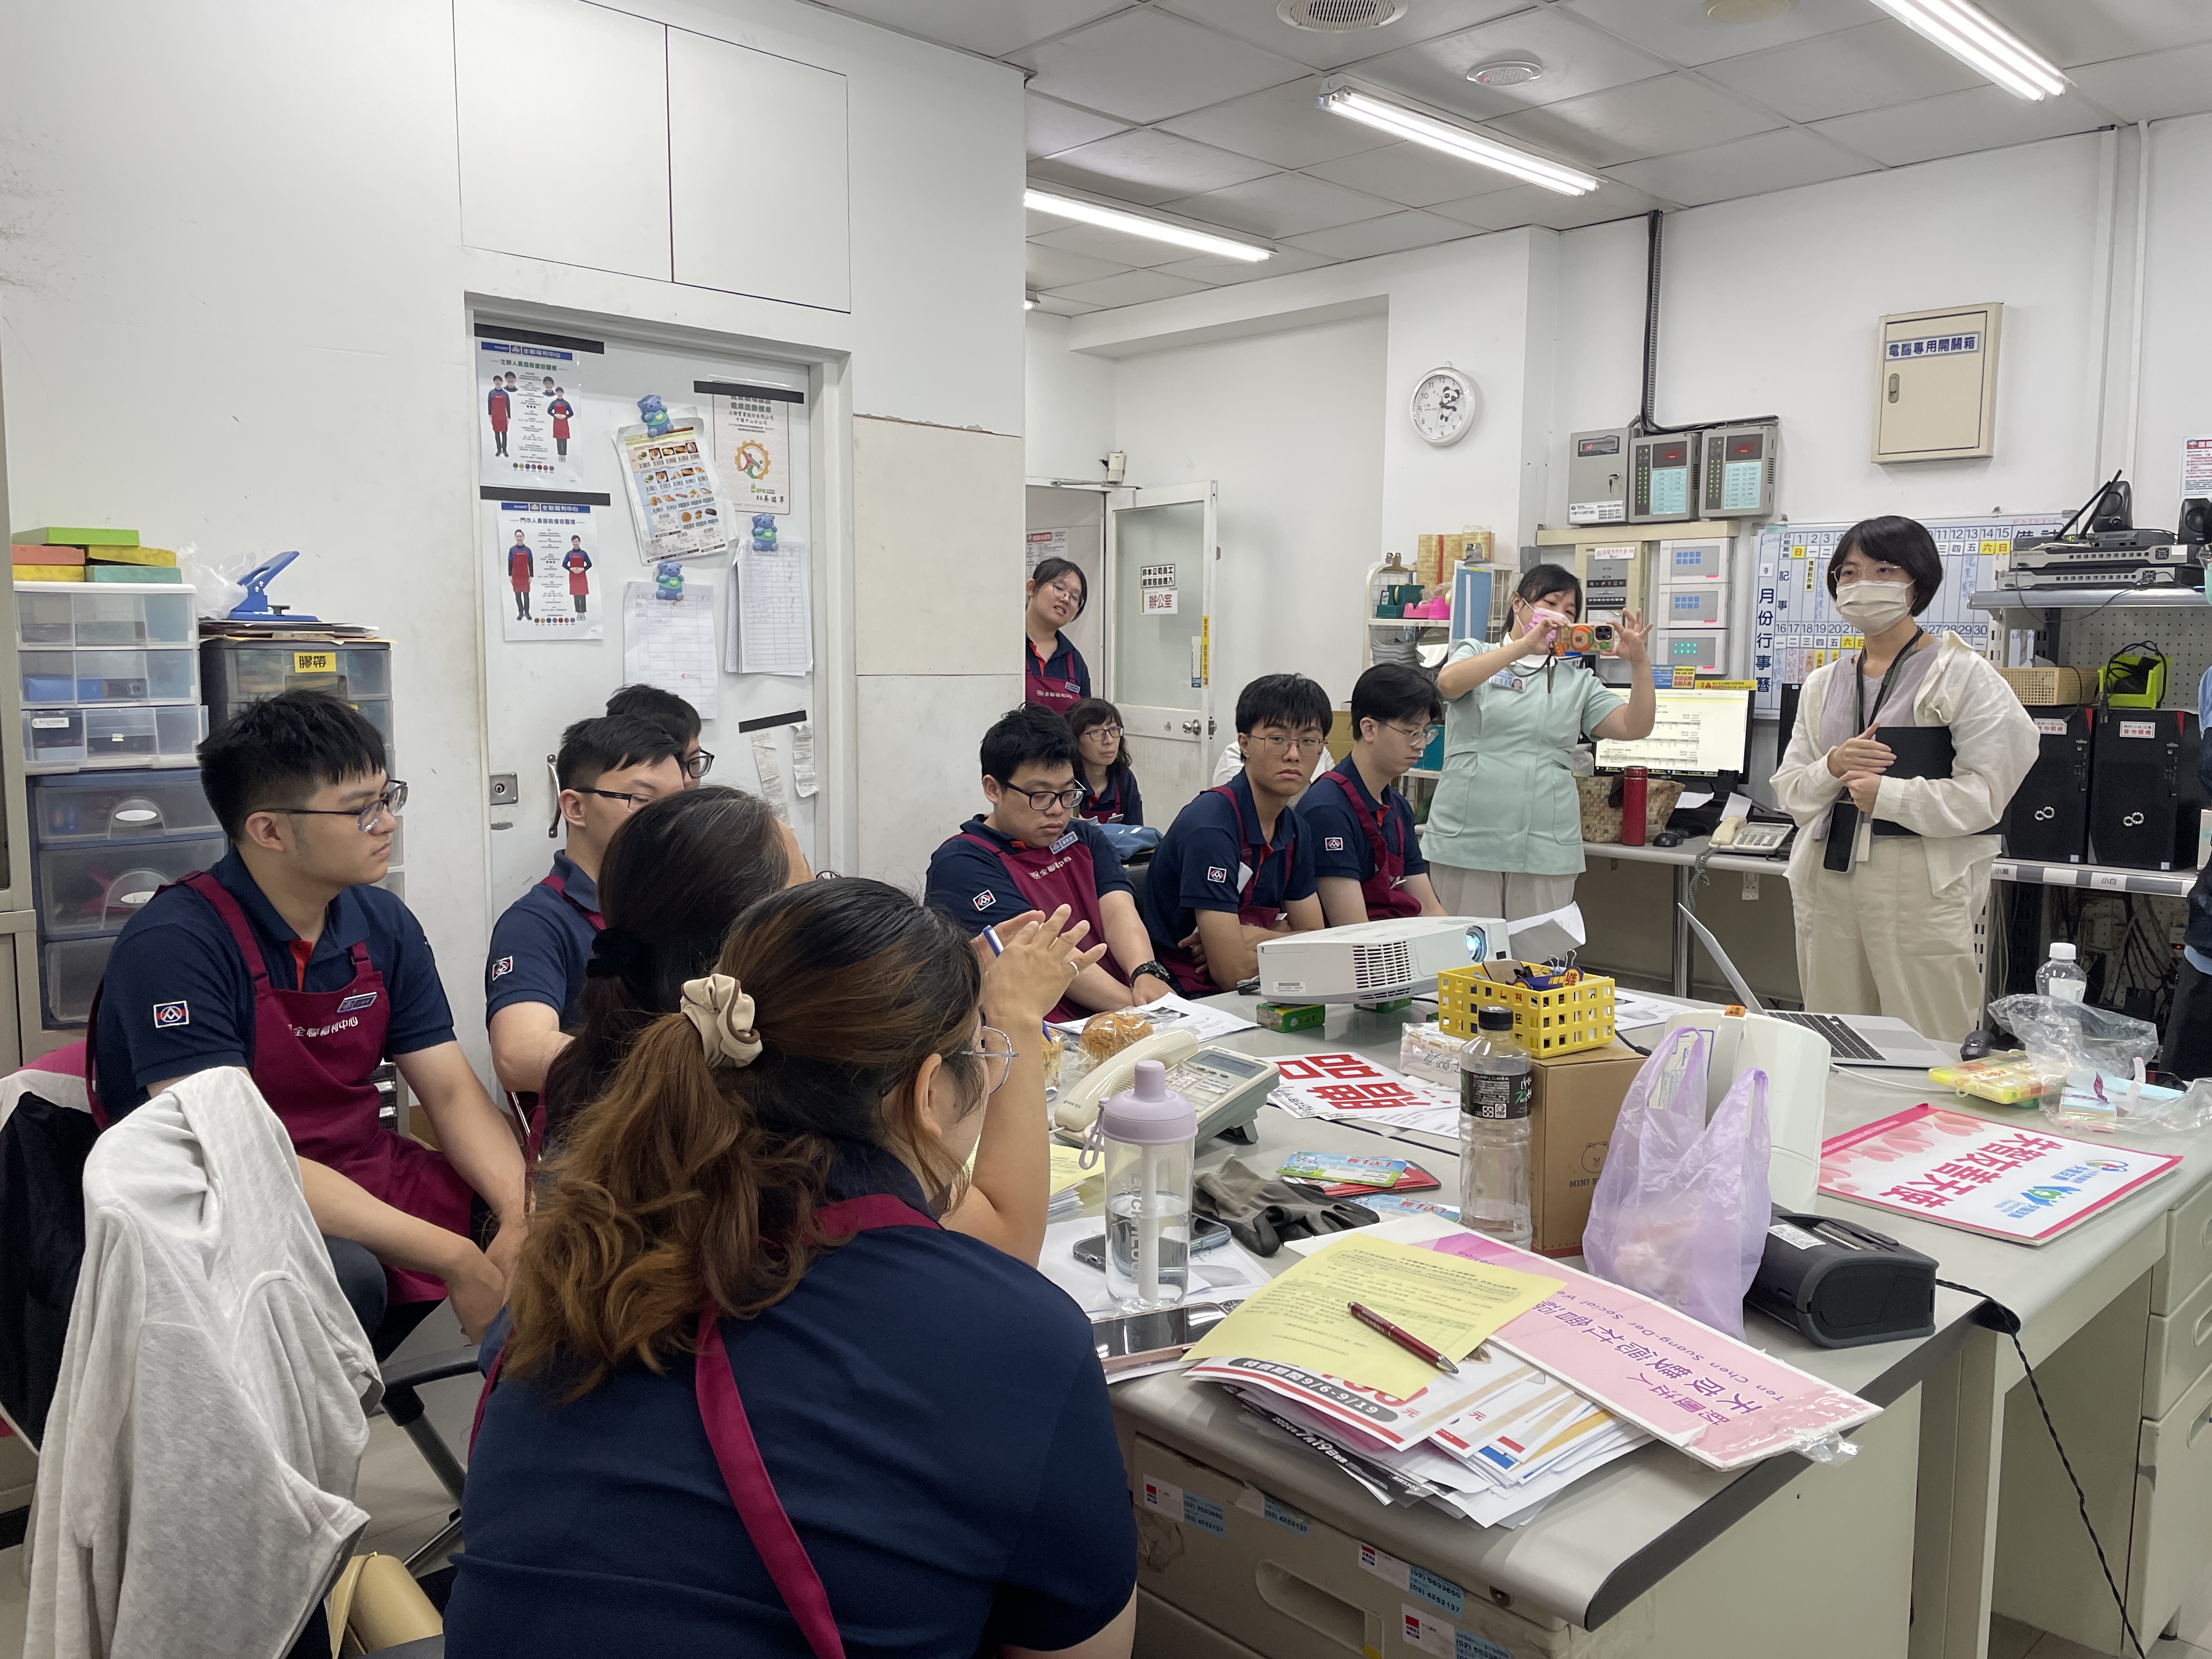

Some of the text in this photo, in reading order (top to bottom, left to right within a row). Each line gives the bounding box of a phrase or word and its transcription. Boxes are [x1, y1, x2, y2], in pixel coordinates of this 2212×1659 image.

[1889, 336, 1976, 357] 電腦專用開關箱
[523, 348, 561, 358] 全聯福利中心
[1937, 530, 1947, 540] 11
[1951, 529, 1963, 539] 12
[1966, 529, 1978, 539] 13
[1981, 528, 1994, 538] 14
[1997, 528, 2010, 538] 15
[1798, 535, 1802, 544] 1
[1811, 534, 1818, 543] 2
[1823, 534, 1830, 543] 3
[1795, 548, 1802, 556] 日
[1967, 544, 1976, 552] 五
[1983, 544, 1992, 552] 六
[1999, 544, 2007, 552] 日
[1143, 567, 1173, 576] 非本公司員工
[1143, 577, 1173, 586] 嚴禁擅自進入
[1149, 594, 1172, 609] 辦公室
[1776, 624, 1786, 633] 16
[1788, 624, 1799, 633] 17
[1802, 624, 1813, 633] 18
[1815, 624, 1826, 633] 19
[1829, 624, 1841, 633] 20
[1843, 624, 1854, 634] 21
[1928, 625, 1942, 635] 27
[1959, 625, 1972, 635] 29
[1973, 625, 1988, 635] 30
[1756, 588, 1774, 692] 月份行事曆
[1803, 637, 1811, 646] 三
[1830, 639, 1838, 647] 五
[1843, 638, 1852, 646] 六
[299, 656, 326, 668] 膠帶
[292, 1016, 358, 1037] 全聯福利中心
[1346, 1156, 1393, 1168] 買1送1
[1878, 1132, 2065, 1210] 失智友善天使
[1570, 1179, 1590, 1188] MINI
[1400, 1200, 1448, 1214] 買1送1
[1581, 1299, 1786, 1402] Ten Chen Suang-Der Social
[1242, 1359, 1379, 1415] 特價期間9/6-9/19
[1626, 1372, 1731, 1426] 財團法人
[1401, 1407, 1420, 1418] 元
[1468, 1410, 1487, 1421] 元
[1184, 1500, 1197, 1510] (02)
[1265, 1508, 1279, 1520] (03)
[1411, 1568, 1425, 1581] (02)
[1410, 1583, 1425, 1595] (03)
[1456, 1639, 1471, 1650] (02)
